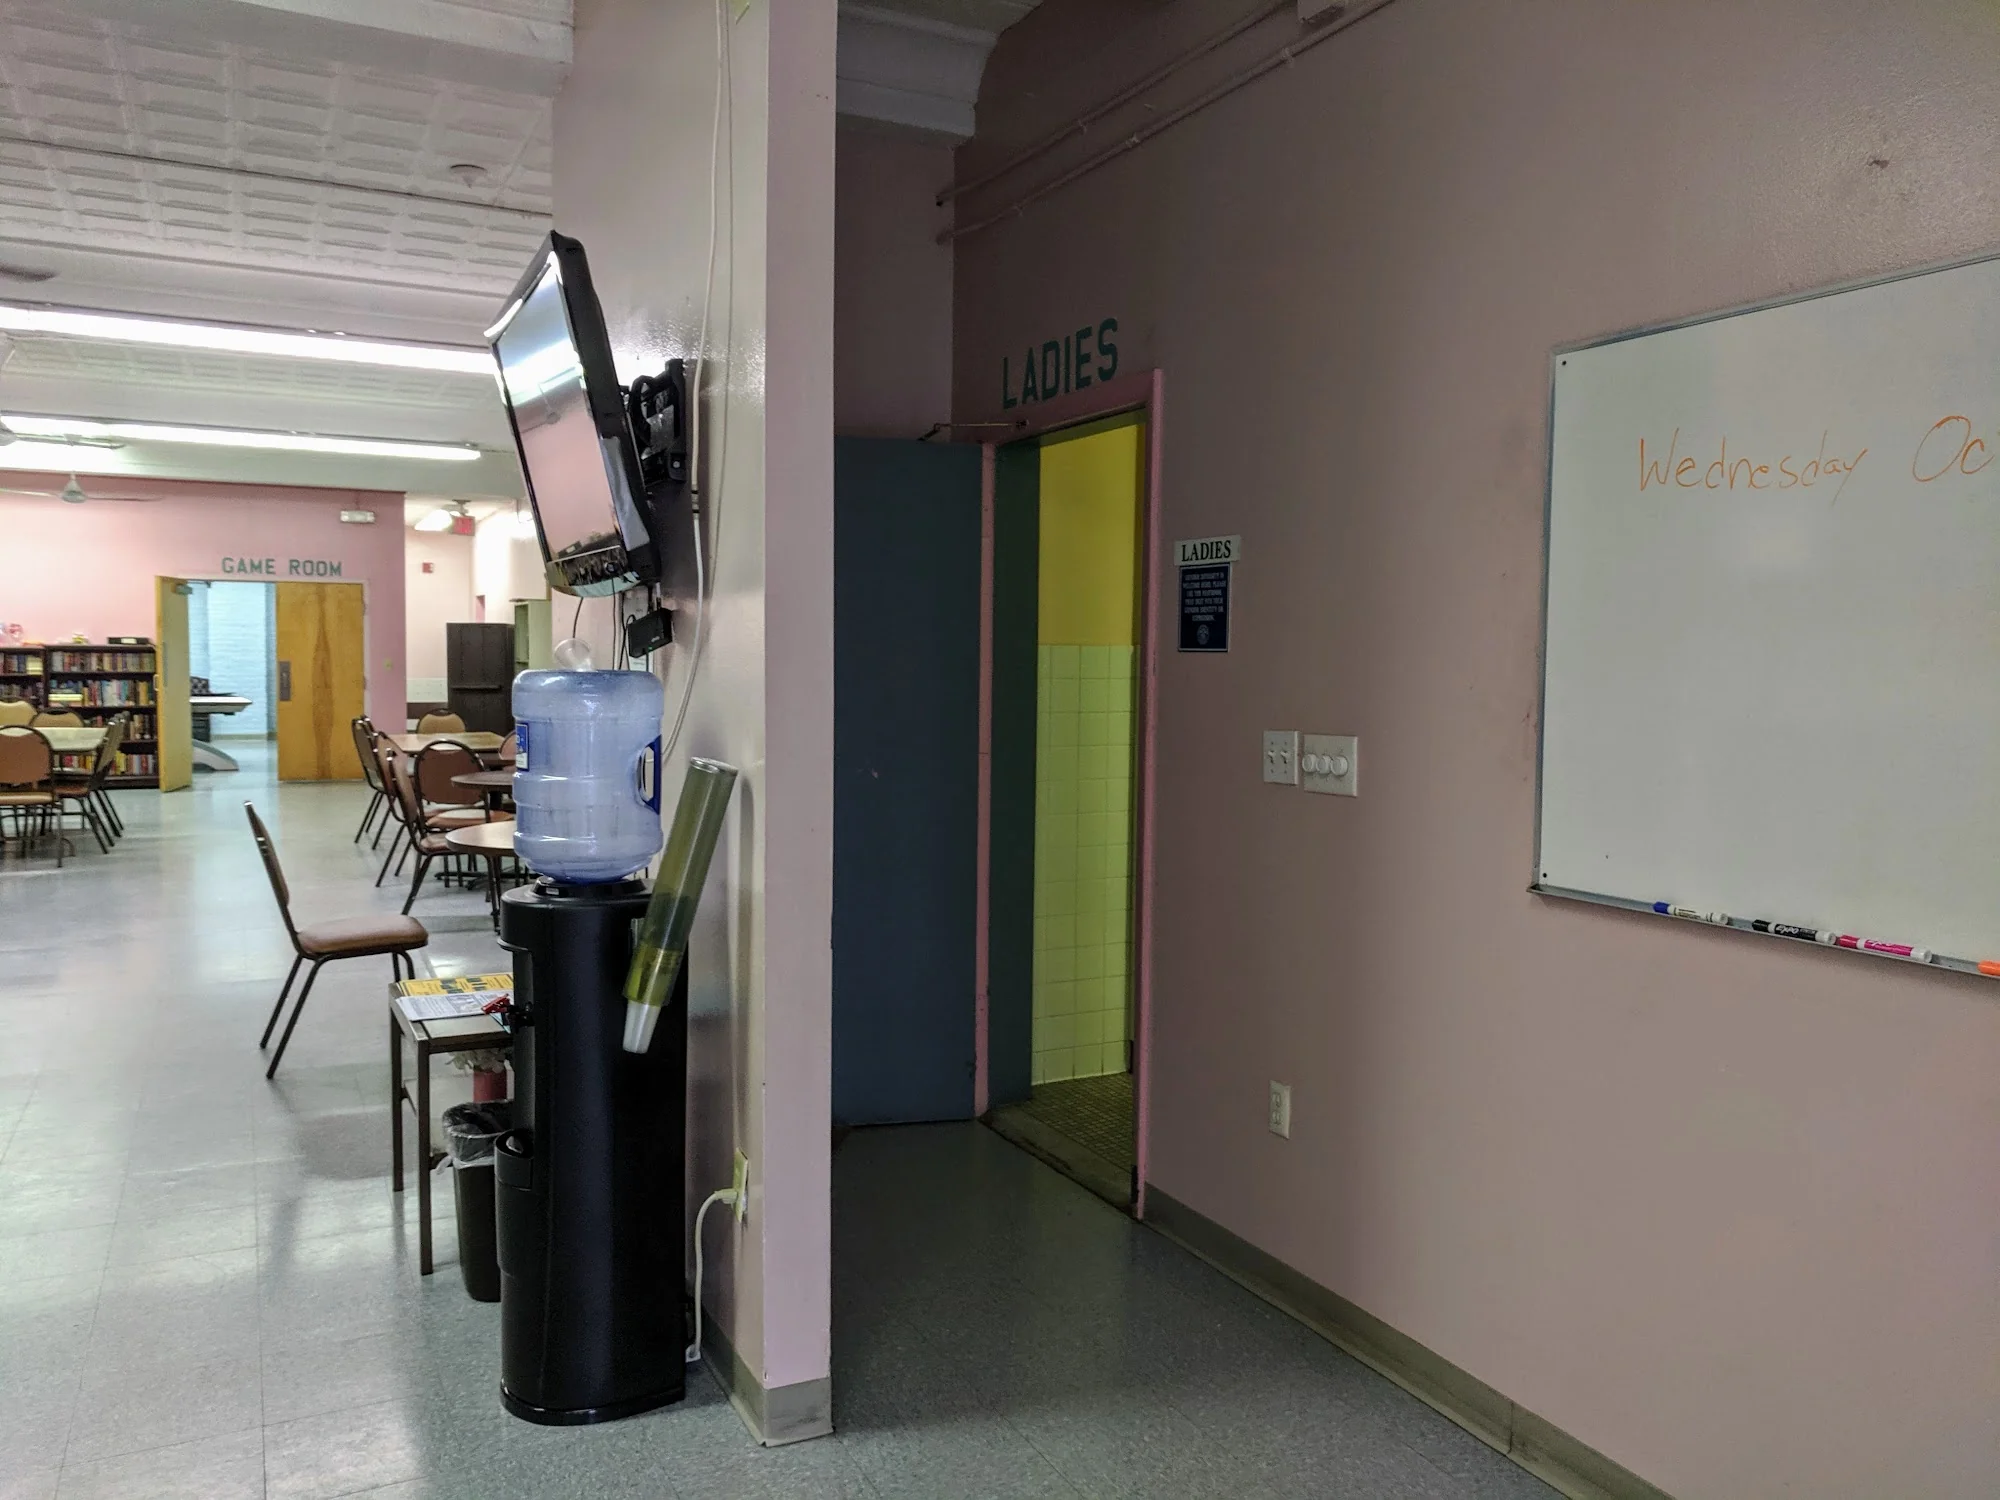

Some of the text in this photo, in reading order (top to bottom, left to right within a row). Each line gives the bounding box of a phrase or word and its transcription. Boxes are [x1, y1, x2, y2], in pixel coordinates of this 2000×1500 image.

[1003, 317, 1118, 409] LADIES
[1639, 427, 1868, 507] Wednesday
[222, 557, 342, 576] GAME ROOM
[1181, 540, 1231, 561] LADIES
